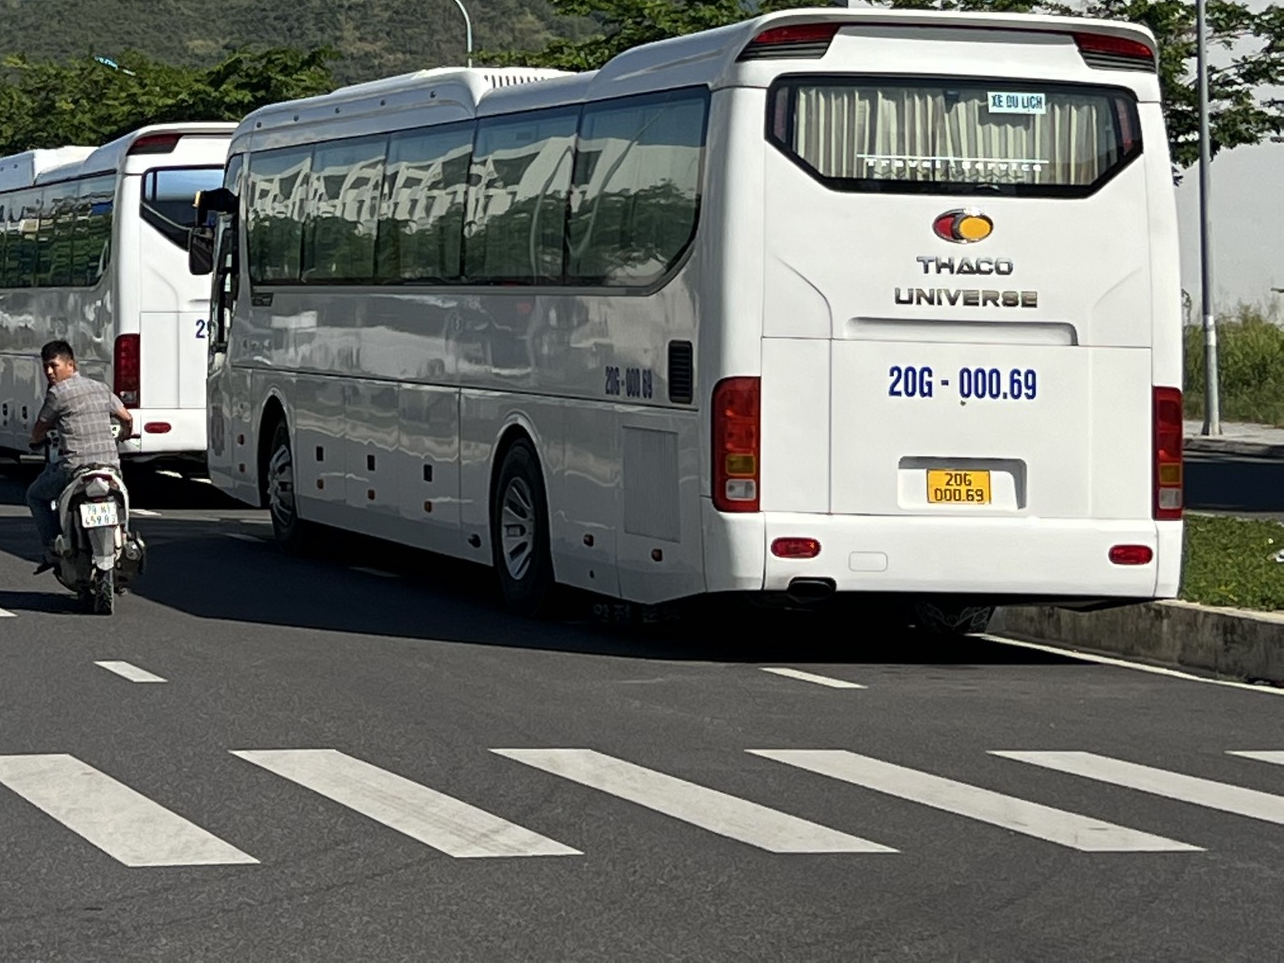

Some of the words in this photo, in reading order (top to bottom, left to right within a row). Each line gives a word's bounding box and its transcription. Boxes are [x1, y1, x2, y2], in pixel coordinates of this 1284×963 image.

[916, 255, 1014, 276] THACO
[894, 287, 1038, 308] UNIVERSE
[888, 365, 933, 398] 20G
[959, 367, 1037, 399] 000.69
[944, 472, 972, 487] 20G
[934, 487, 984, 503] 000.69
